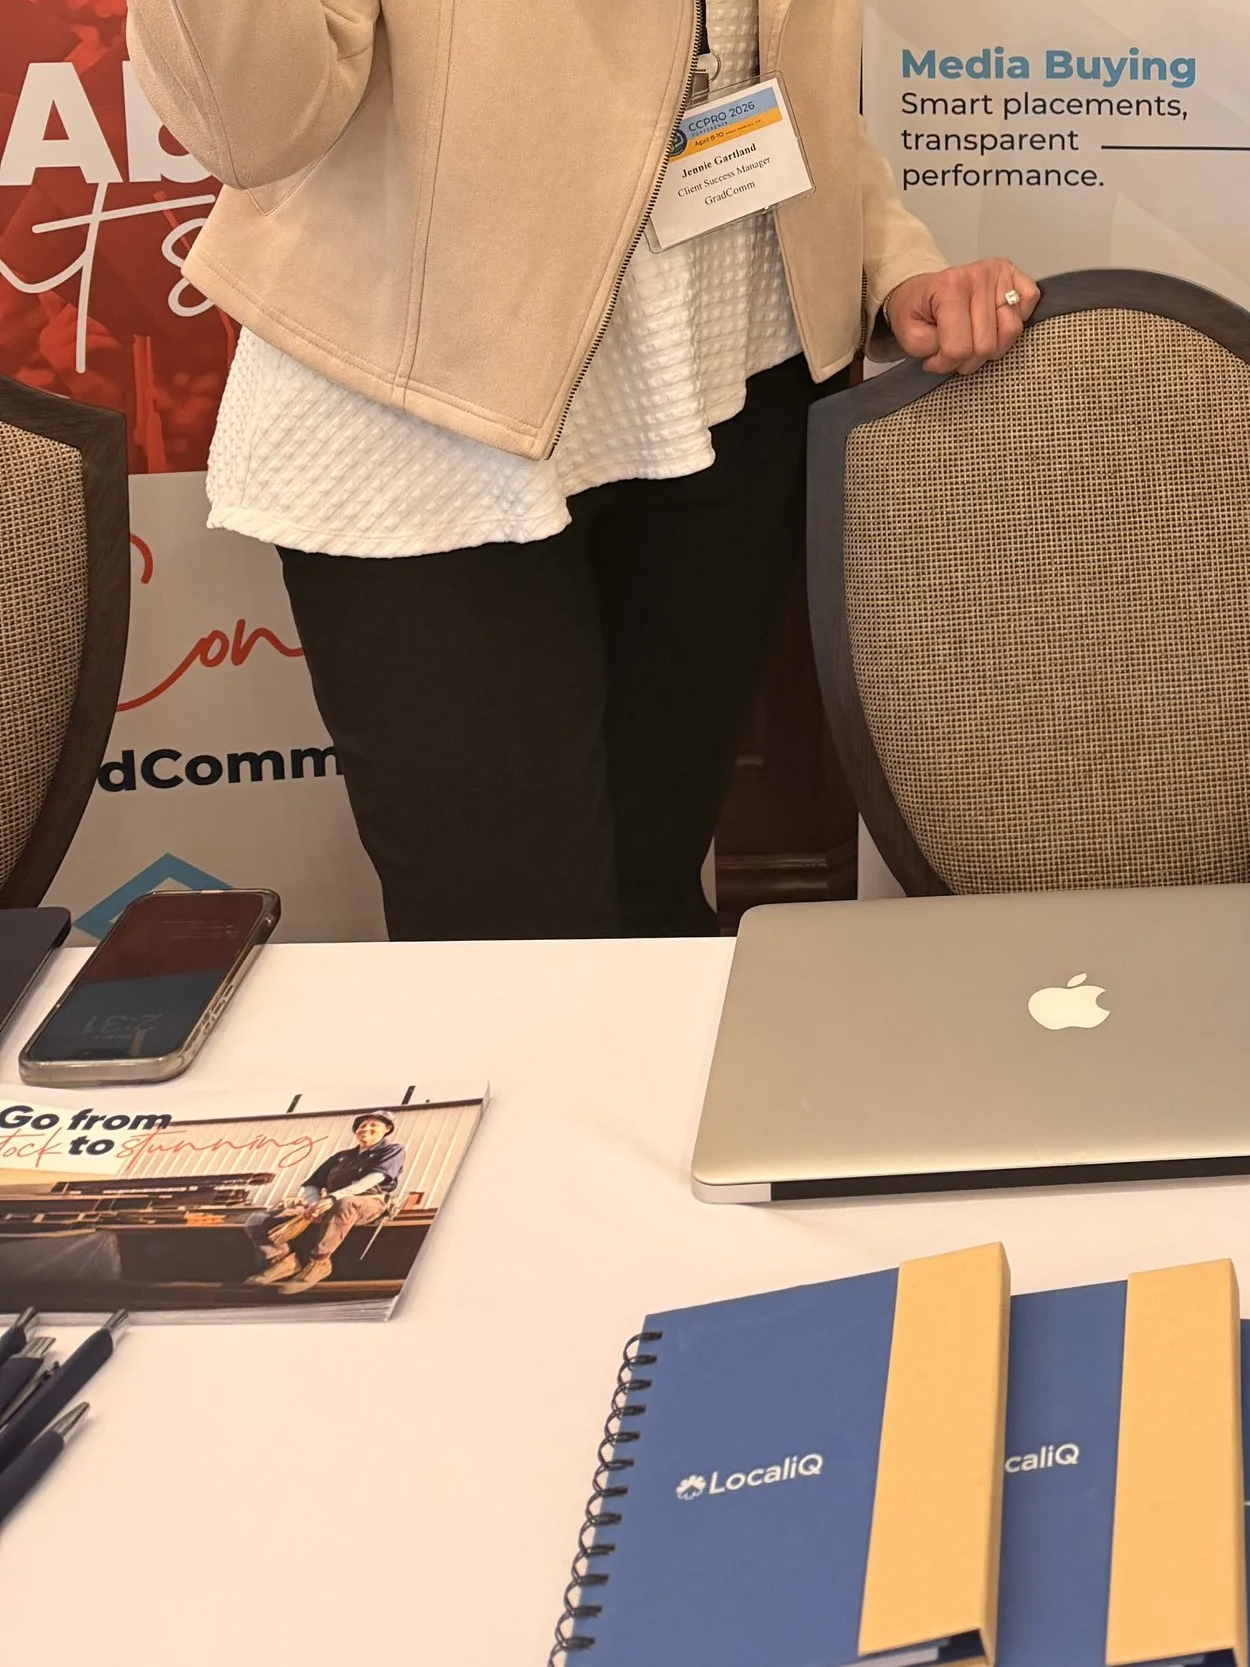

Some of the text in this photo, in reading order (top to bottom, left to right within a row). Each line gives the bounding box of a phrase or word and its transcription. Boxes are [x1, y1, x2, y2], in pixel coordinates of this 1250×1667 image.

[901, 46, 1197, 89] Media Buying
[688, 111, 727, 132] CCPRO
[729, 101, 755, 118] 2026
[901, 92, 1189, 122] Smart placements,
[901, 128, 1080, 157] transparent
[681, 142, 758, 179] Jennie Gartland
[677, 155, 771, 198] Client Success Manager
[901, 163, 1105, 192] performance.
[704, 180, 756, 207] GradComm
[0, 1104, 172, 1131] Go from
[0, 1122, 329, 1170] tock to stunning
[1004, 1442, 1080, 1474] caliQ
[708, 1453, 824, 1495] LocaliQ
